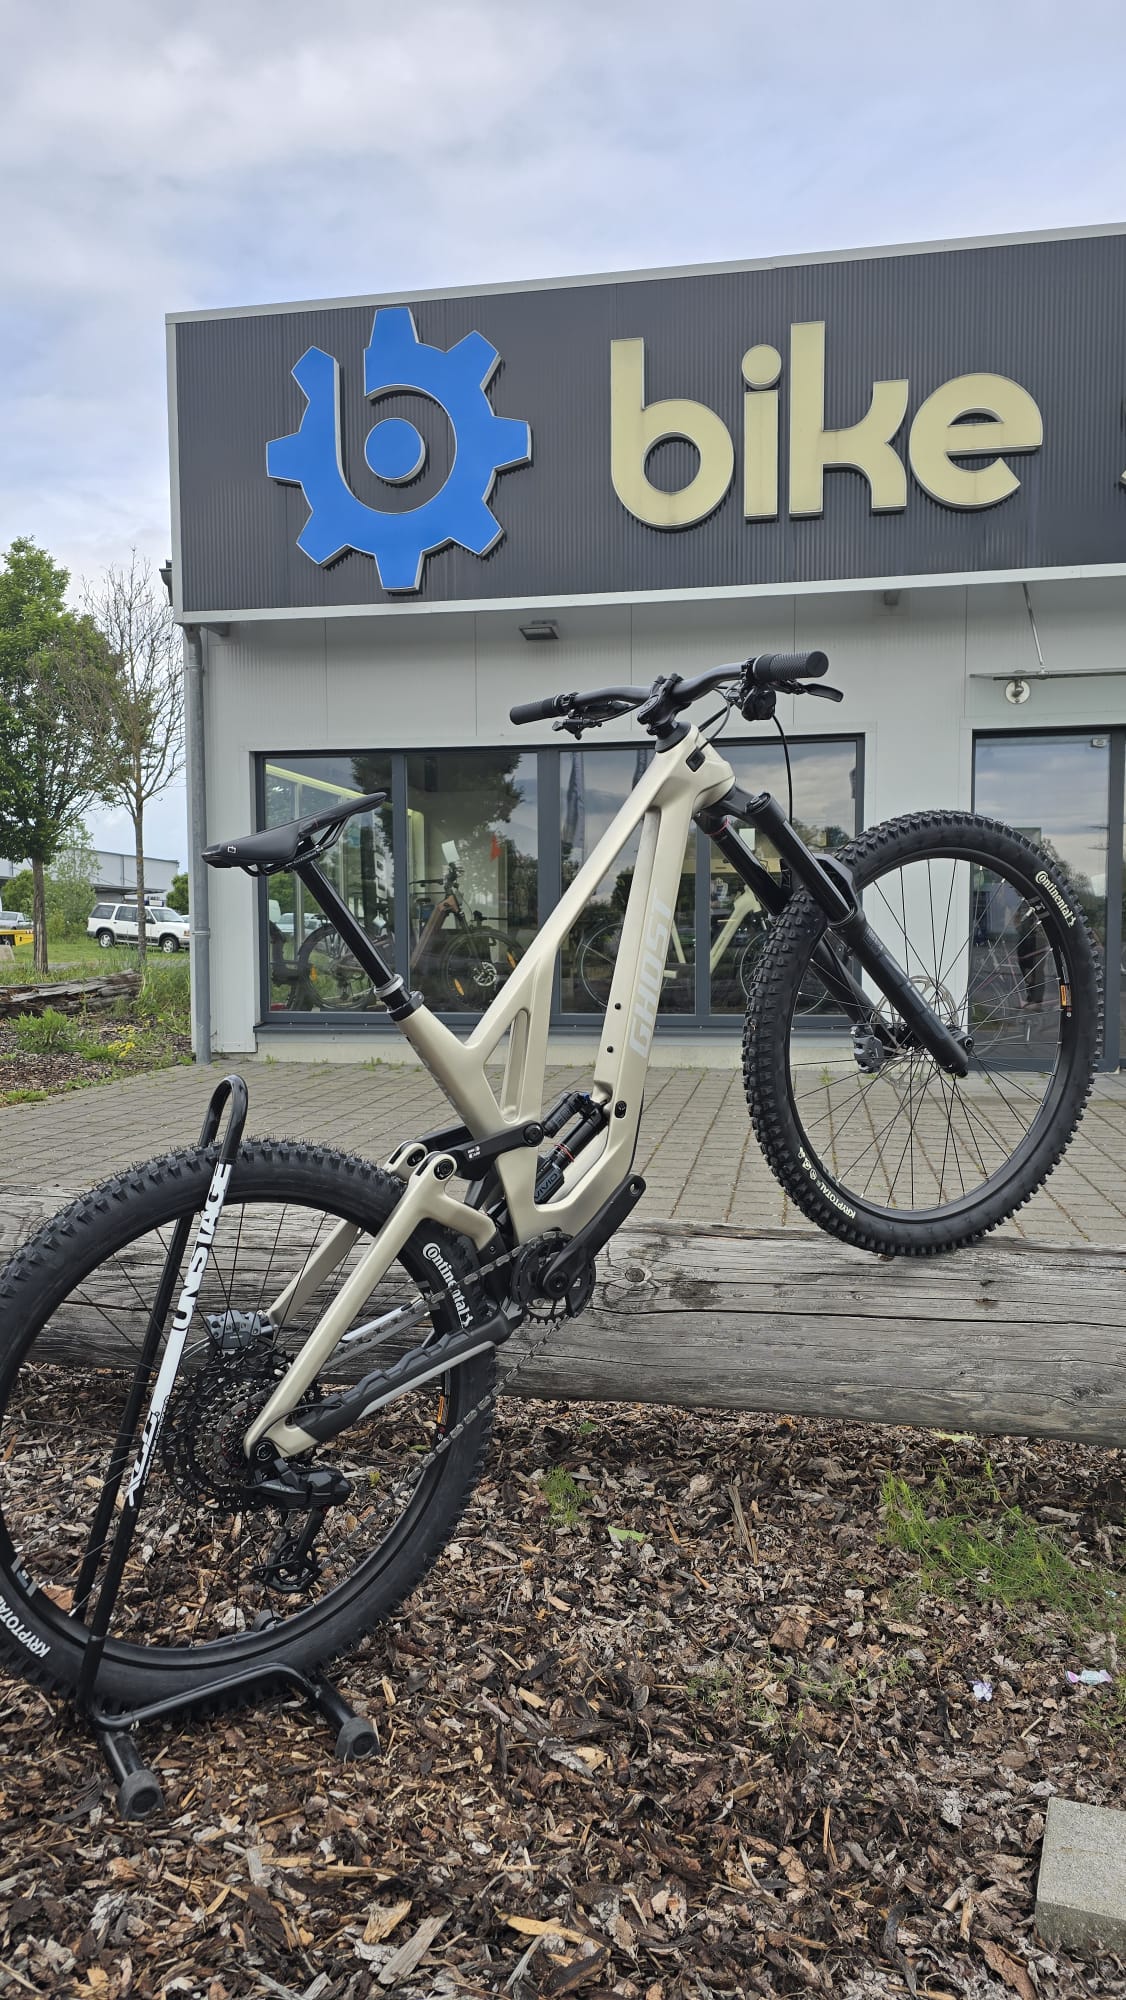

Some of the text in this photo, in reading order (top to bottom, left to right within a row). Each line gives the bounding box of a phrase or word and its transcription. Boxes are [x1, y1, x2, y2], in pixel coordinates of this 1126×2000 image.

[611, 321, 1043, 529] bike
[1035, 870, 1075, 925] Continental
[629, 887, 672, 1059] GHOST
[534, 1172, 558, 1199] VIVID
[819, 1181, 857, 1219] KRYPTOTAL
